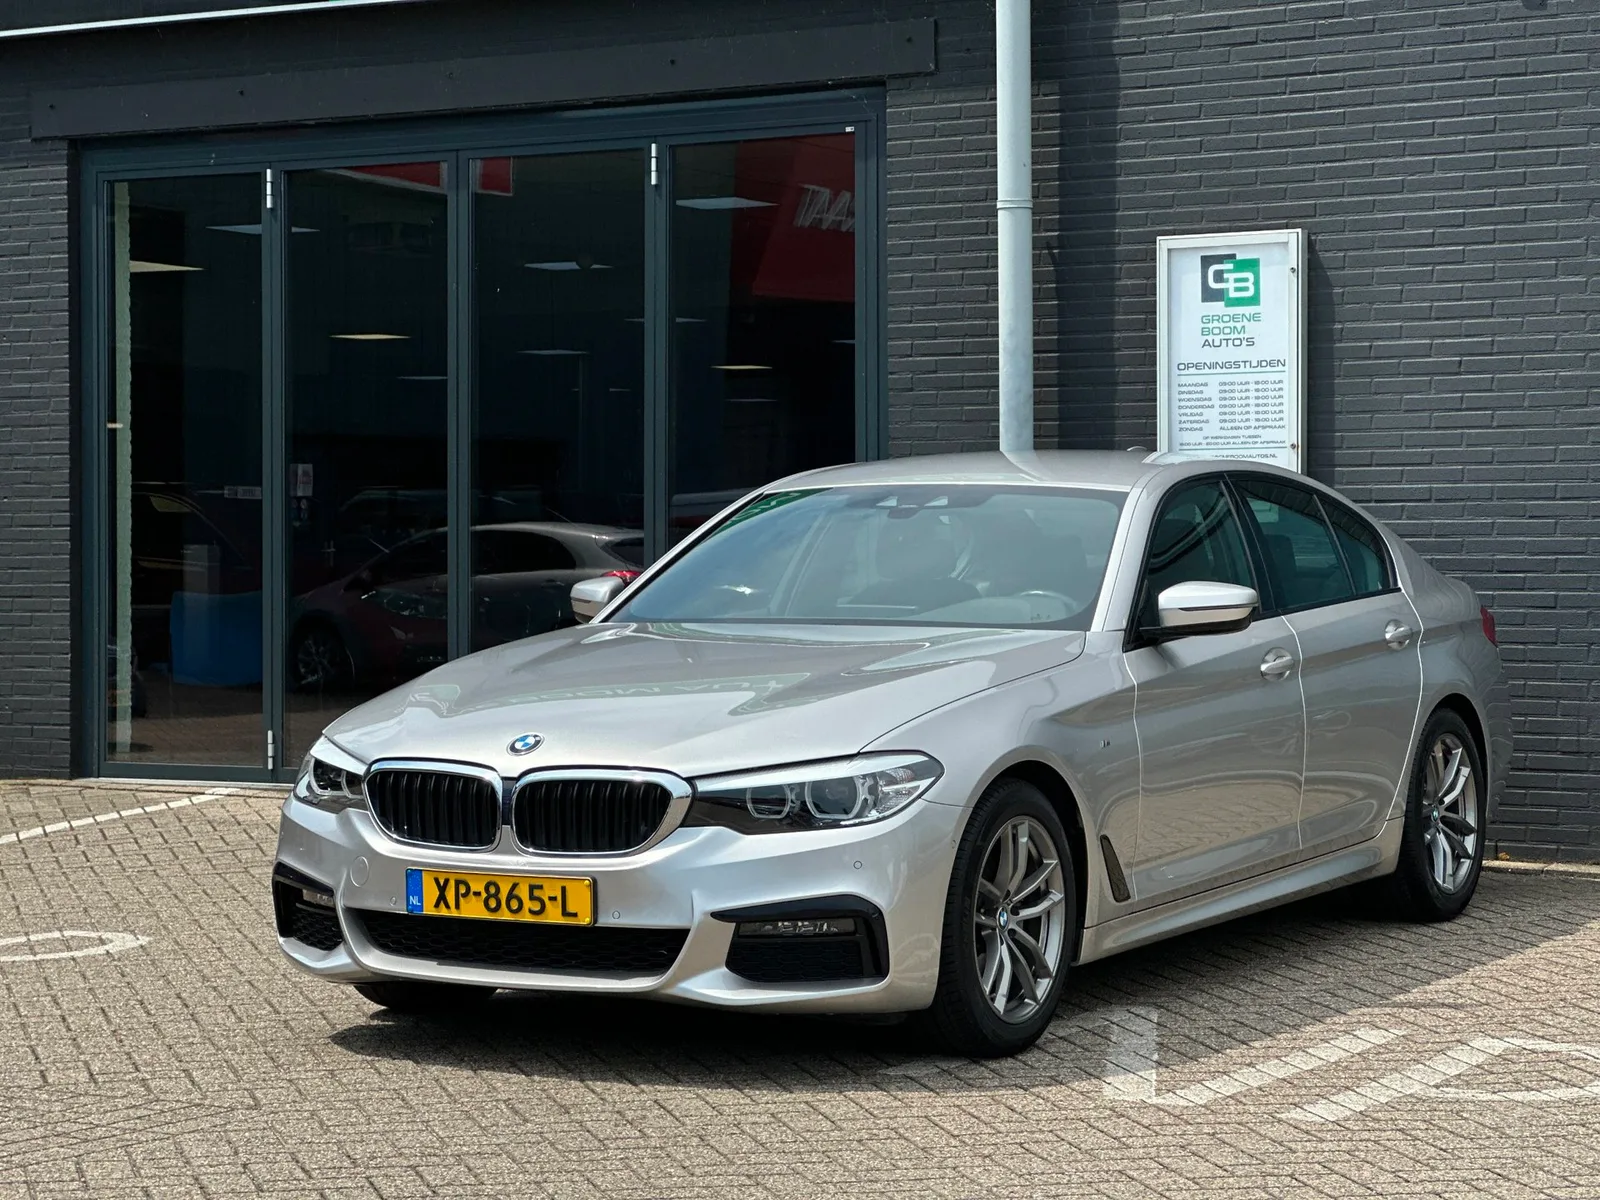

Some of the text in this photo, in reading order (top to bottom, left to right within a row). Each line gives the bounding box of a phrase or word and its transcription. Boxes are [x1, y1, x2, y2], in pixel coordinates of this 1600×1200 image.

[1201, 312, 1262, 325] GROENE
[1201, 325, 1246, 336] BOOM
[1201, 336, 1256, 349] AUTO'S
[1177, 359, 1286, 372] OPENINGSTIJDEN
[409, 896, 421, 906] NL
[433, 876, 578, 918] XP-865-L
